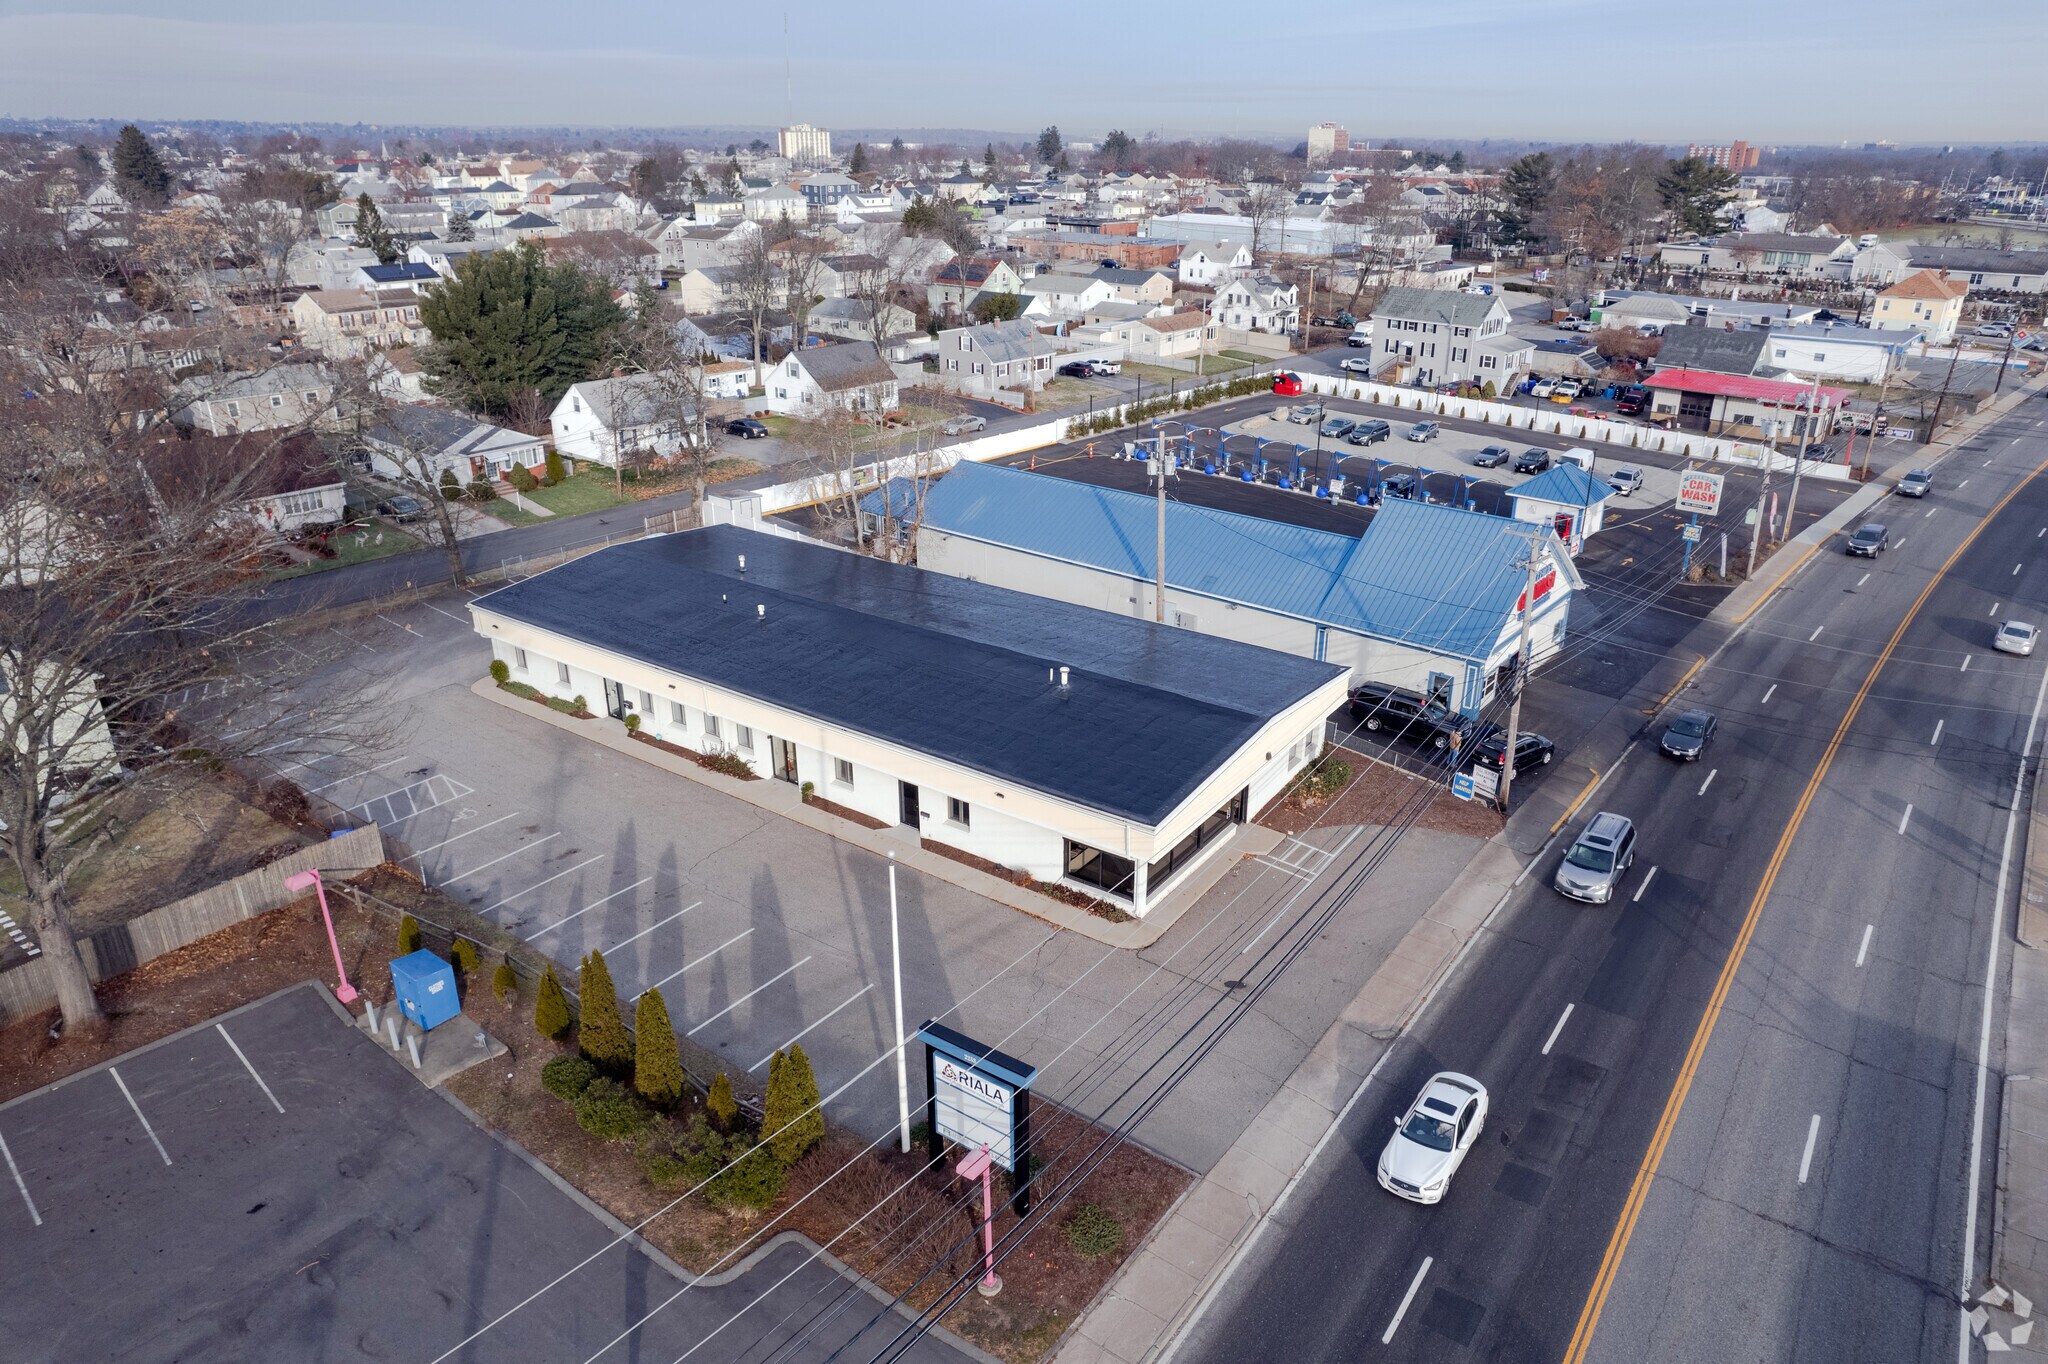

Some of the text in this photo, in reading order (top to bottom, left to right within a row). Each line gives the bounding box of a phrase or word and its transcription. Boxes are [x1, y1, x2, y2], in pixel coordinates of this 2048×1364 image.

[1689, 480, 1712, 492] CAR
[1681, 489, 1716, 503] WASH
[1455, 785, 1471, 794] WANTED
